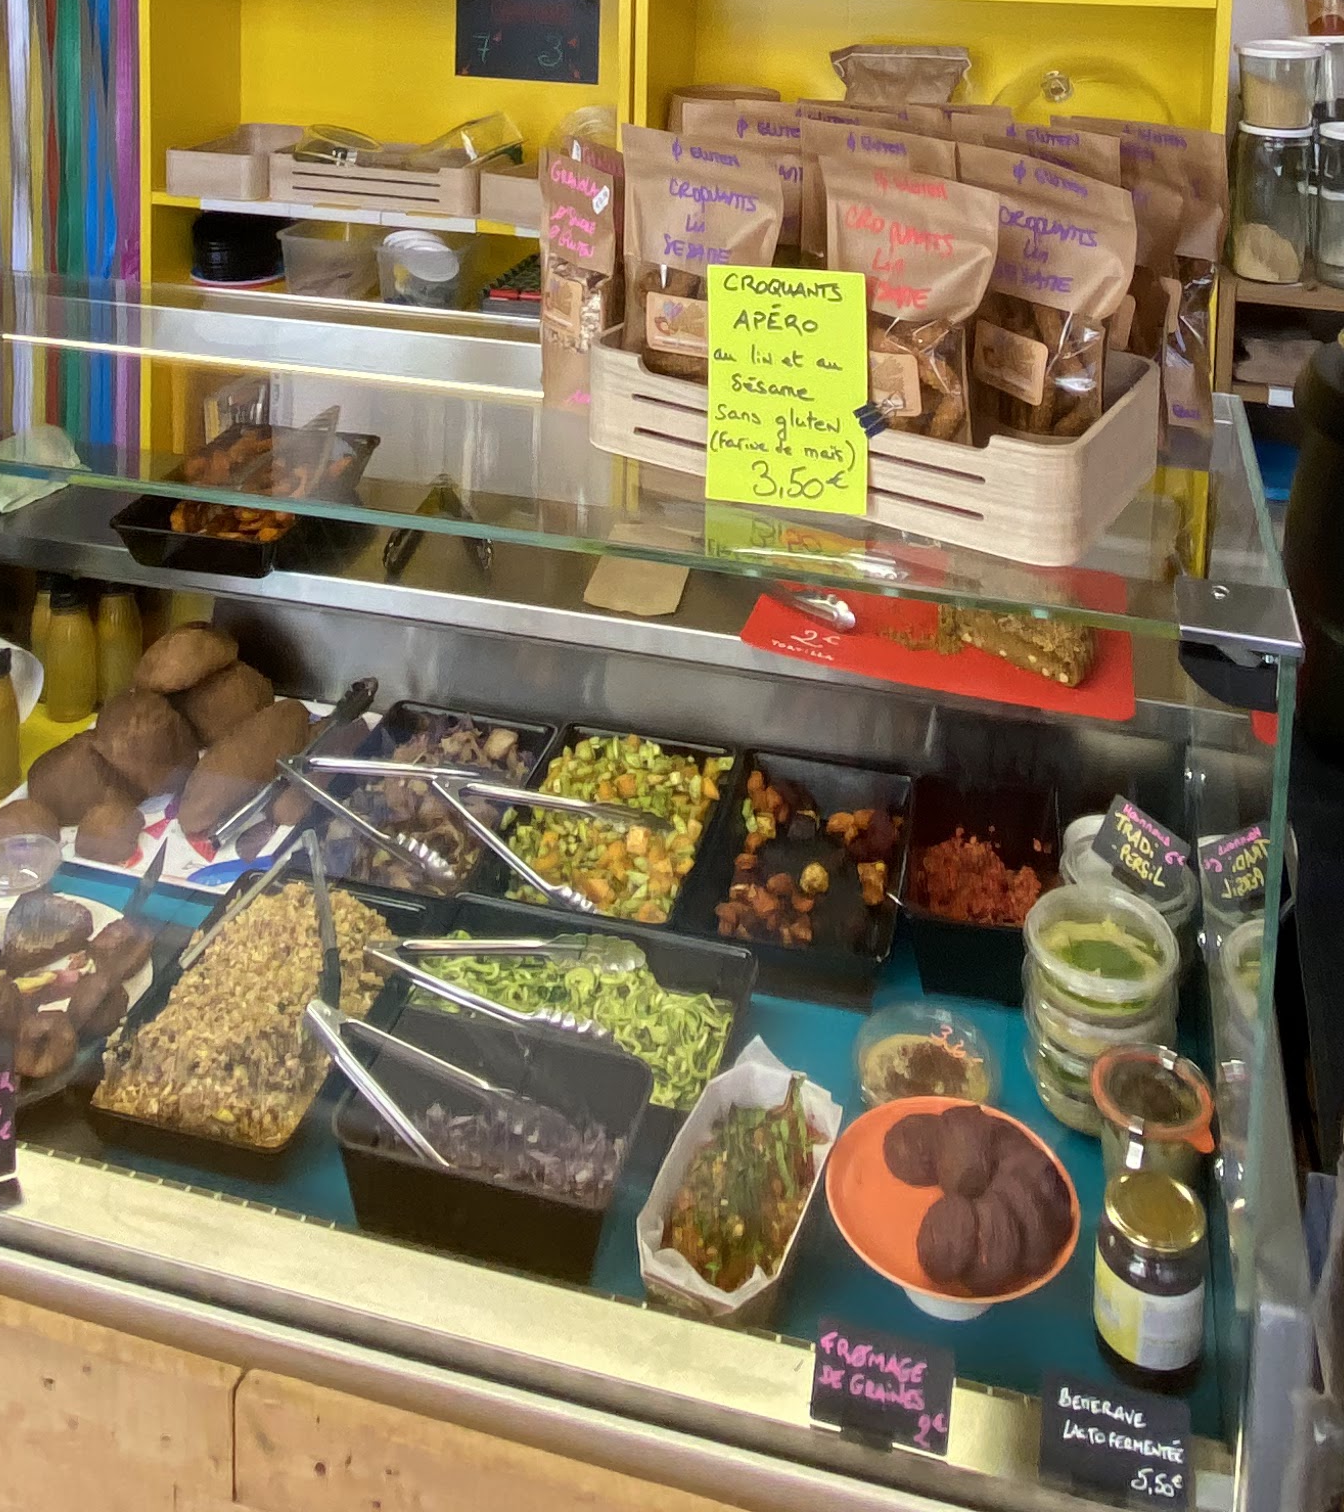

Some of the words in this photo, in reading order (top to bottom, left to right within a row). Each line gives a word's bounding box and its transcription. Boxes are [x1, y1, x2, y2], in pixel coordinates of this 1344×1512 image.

[723, 272, 844, 302] CROQUANTS
[733, 304, 819, 337] APÉRO
[713, 347, 737, 363] au
[781, 351, 804, 368] et
[816, 357, 844, 372] au
[775, 438, 793, 456] de
[752, 460, 849, 500] 3,50€
[819, 1330, 927, 1385] FROMAGE
[818, 1364, 843, 1389] DE
[1058, 1387, 1147, 1428] BETTERAVE
[1130, 1468, 1183, 1498] 5,50€
